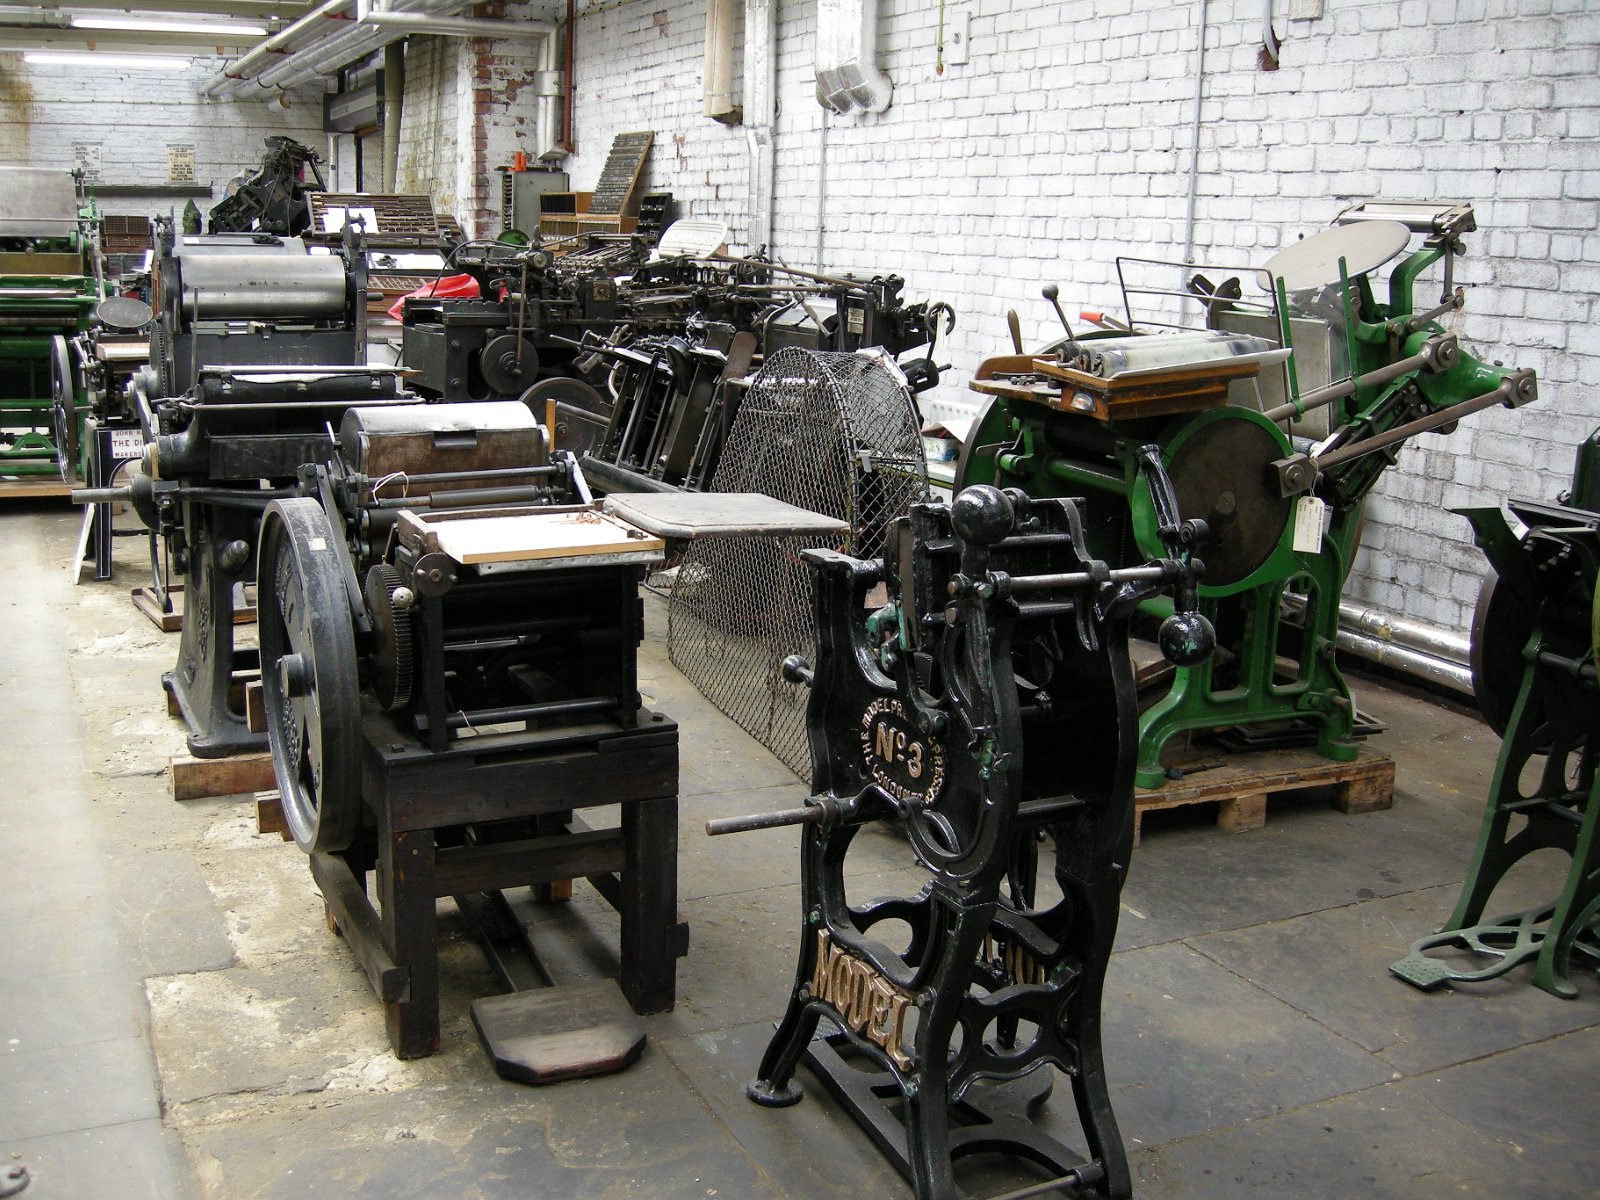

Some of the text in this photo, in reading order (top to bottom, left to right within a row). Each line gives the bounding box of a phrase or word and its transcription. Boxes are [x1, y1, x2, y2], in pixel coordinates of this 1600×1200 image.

[861, 698, 890, 728] MODEL
[906, 740, 924, 779] 3
[871, 762, 910, 798] LONDON
[810, 928, 913, 1072] MODEL
